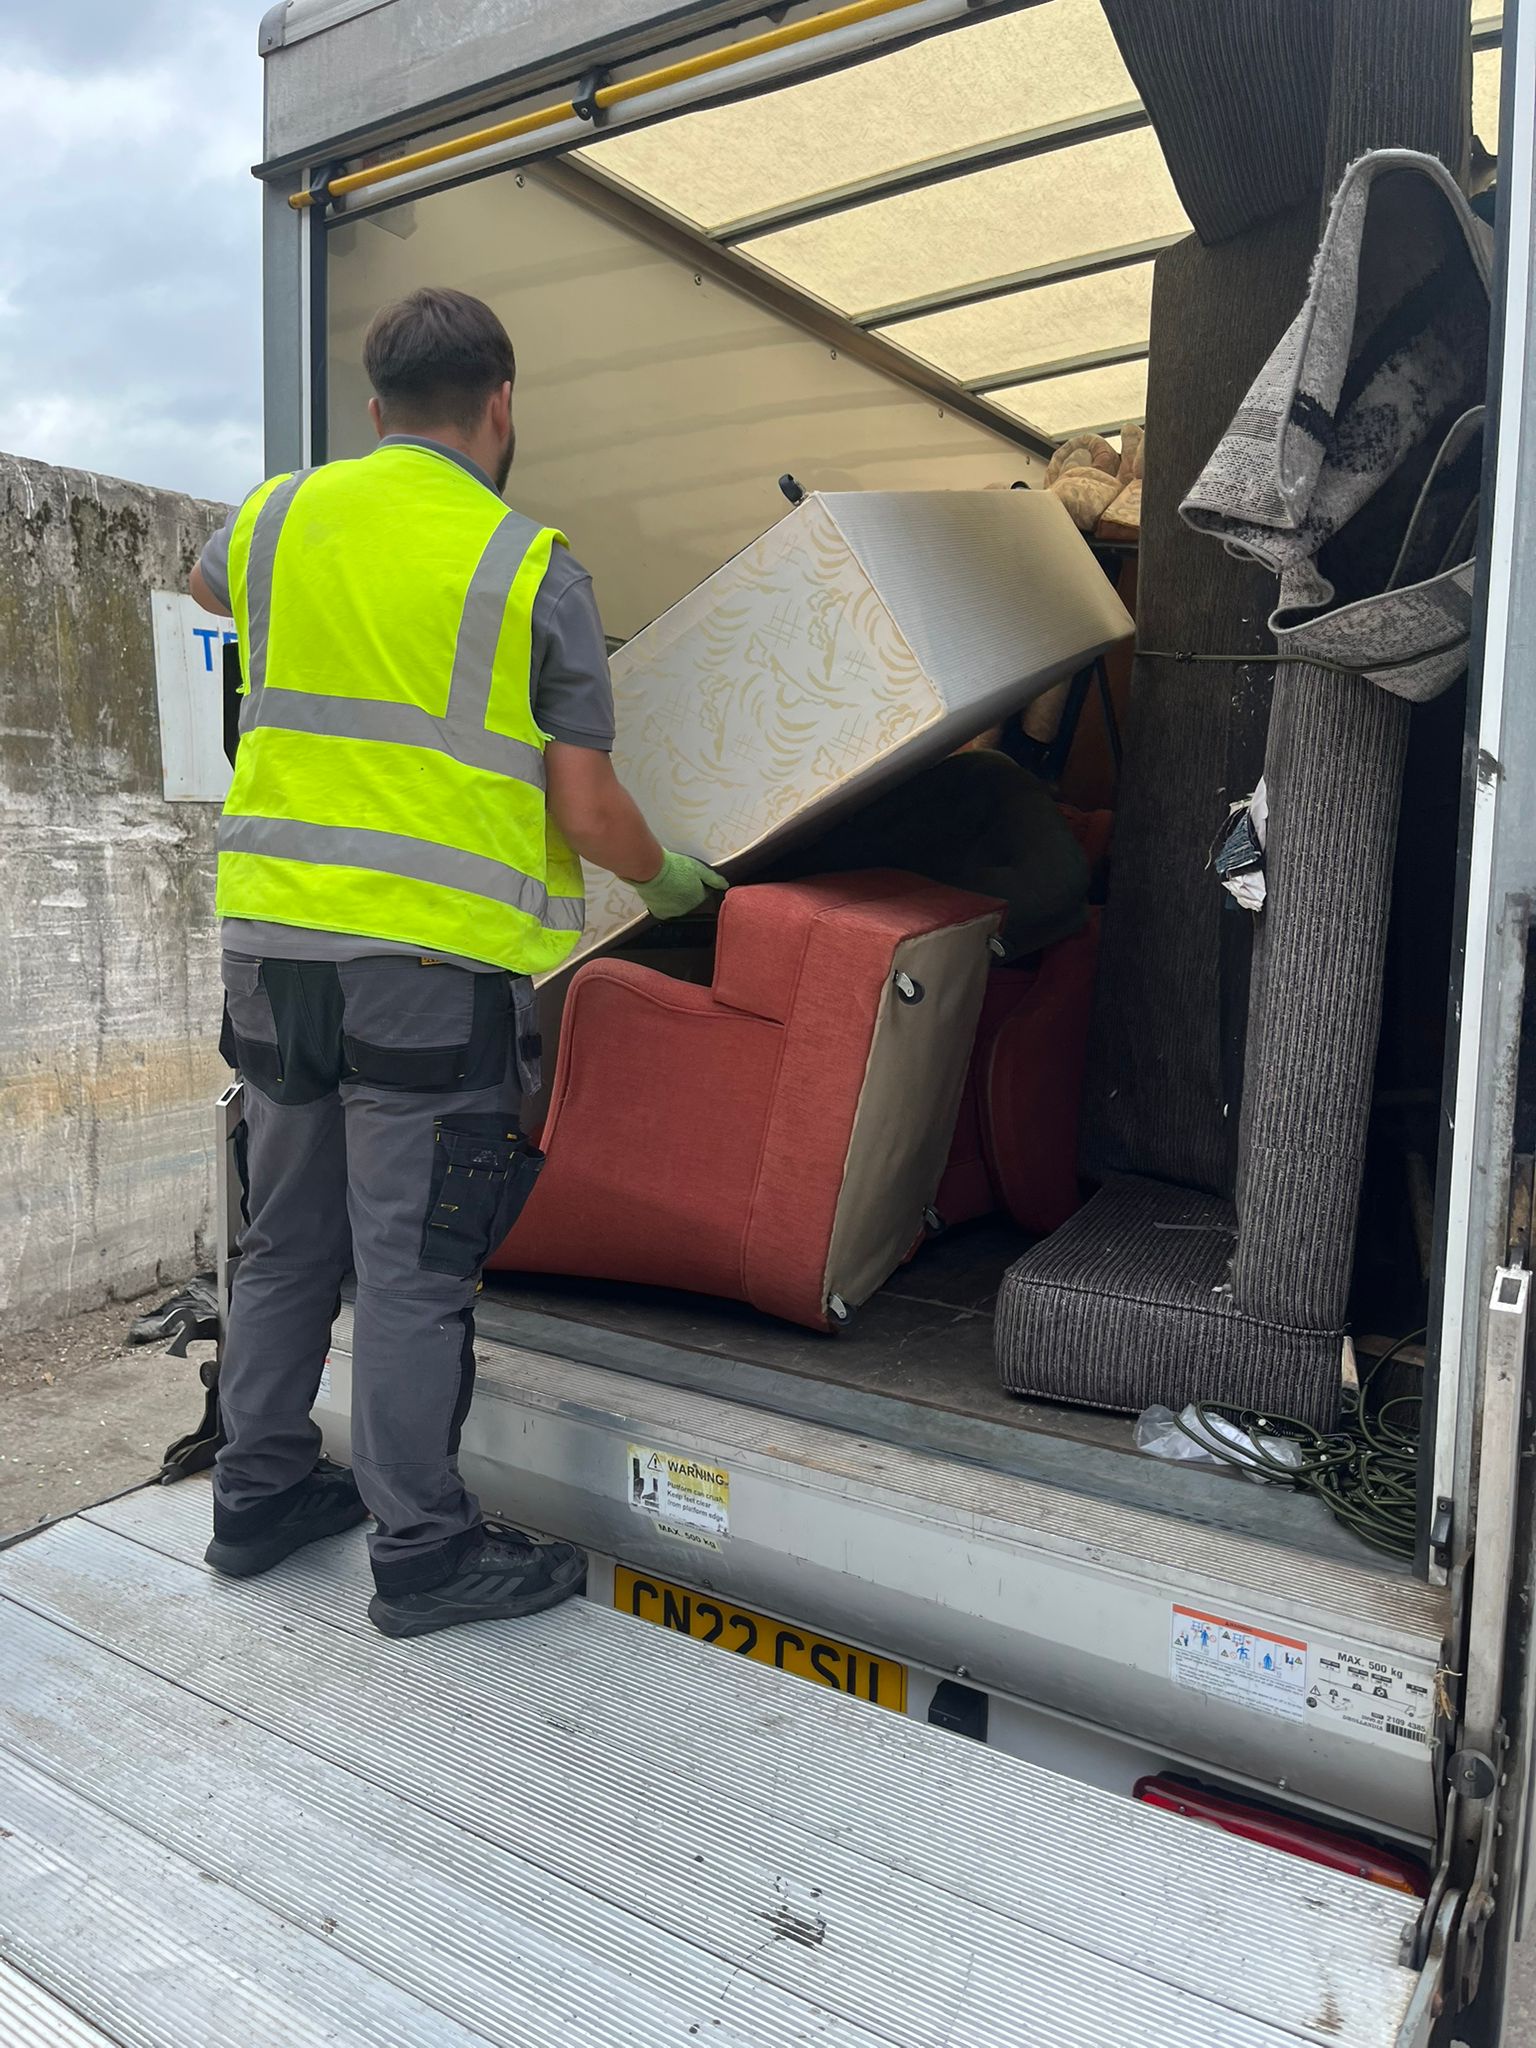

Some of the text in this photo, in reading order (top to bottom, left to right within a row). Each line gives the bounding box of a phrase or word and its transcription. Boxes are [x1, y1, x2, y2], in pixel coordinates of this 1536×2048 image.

[668, 1460, 725, 1486] WARNING
[667, 1480, 693, 1494] Platform
[694, 1488, 705, 1498] can
[667, 1490, 712, 1509] Keep feet clear
[667, 1499, 682, 1509] from
[682, 1502, 708, 1517] platform
[632, 1579, 758, 1656] CN22
[1337, 1652, 1365, 1668] MAX.
[1368, 1661, 1388, 1674] 500
[1391, 1667, 1404, 1680] kg
